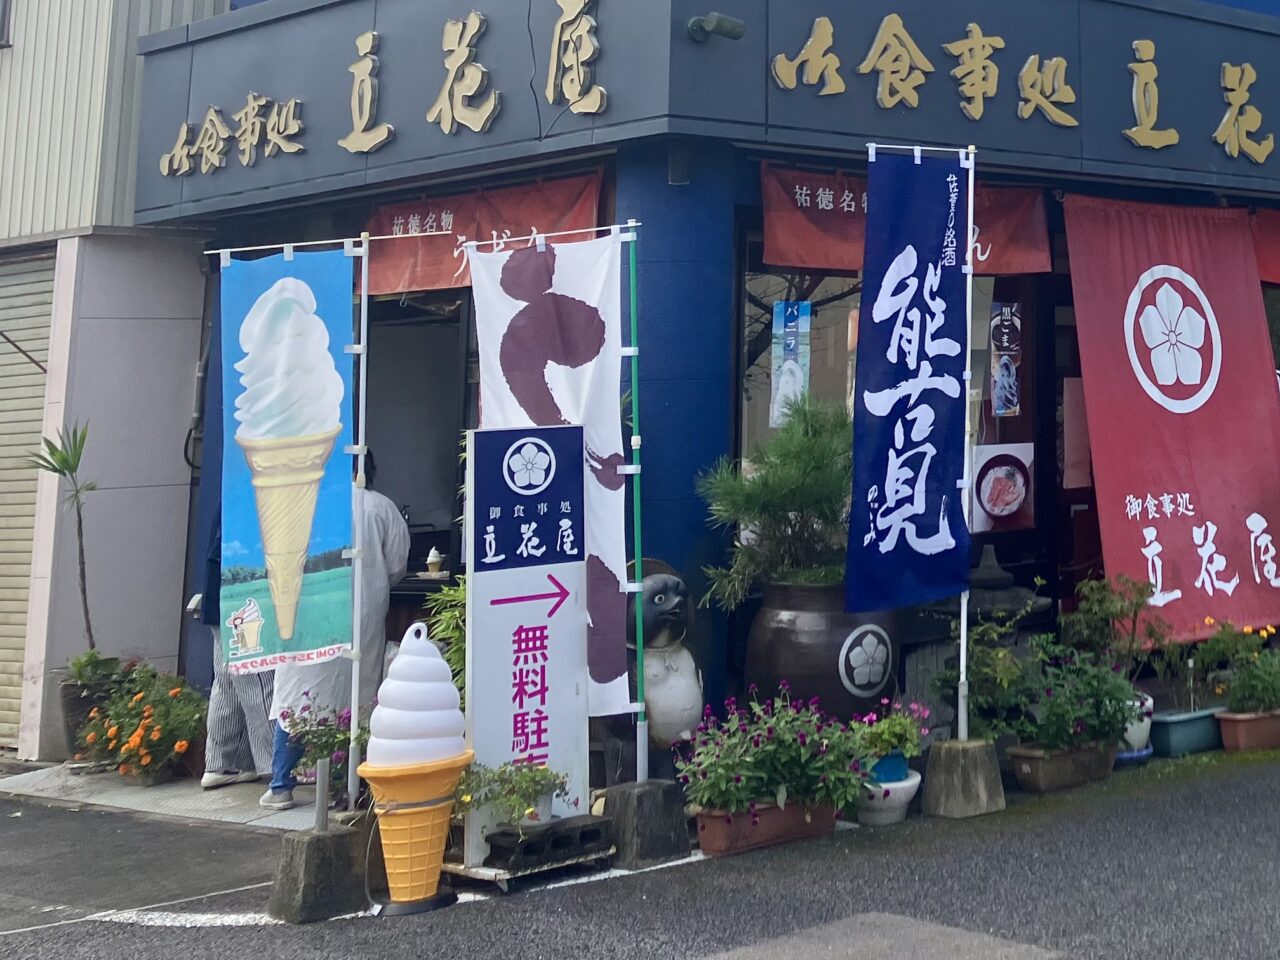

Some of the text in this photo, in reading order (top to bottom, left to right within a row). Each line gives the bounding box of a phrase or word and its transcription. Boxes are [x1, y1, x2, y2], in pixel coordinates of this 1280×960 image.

[392, 209, 454, 236] 祐徳名物
[942, 174, 959, 266] 佐賀の銘酒
[785, 305, 798, 350] バニラ
[864, 244, 961, 555] 能古見
[489, 501, 571, 519] 御食事処
[1125, 493, 1196, 521] 御食事処
[480, 518, 578, 563] 立花屋
